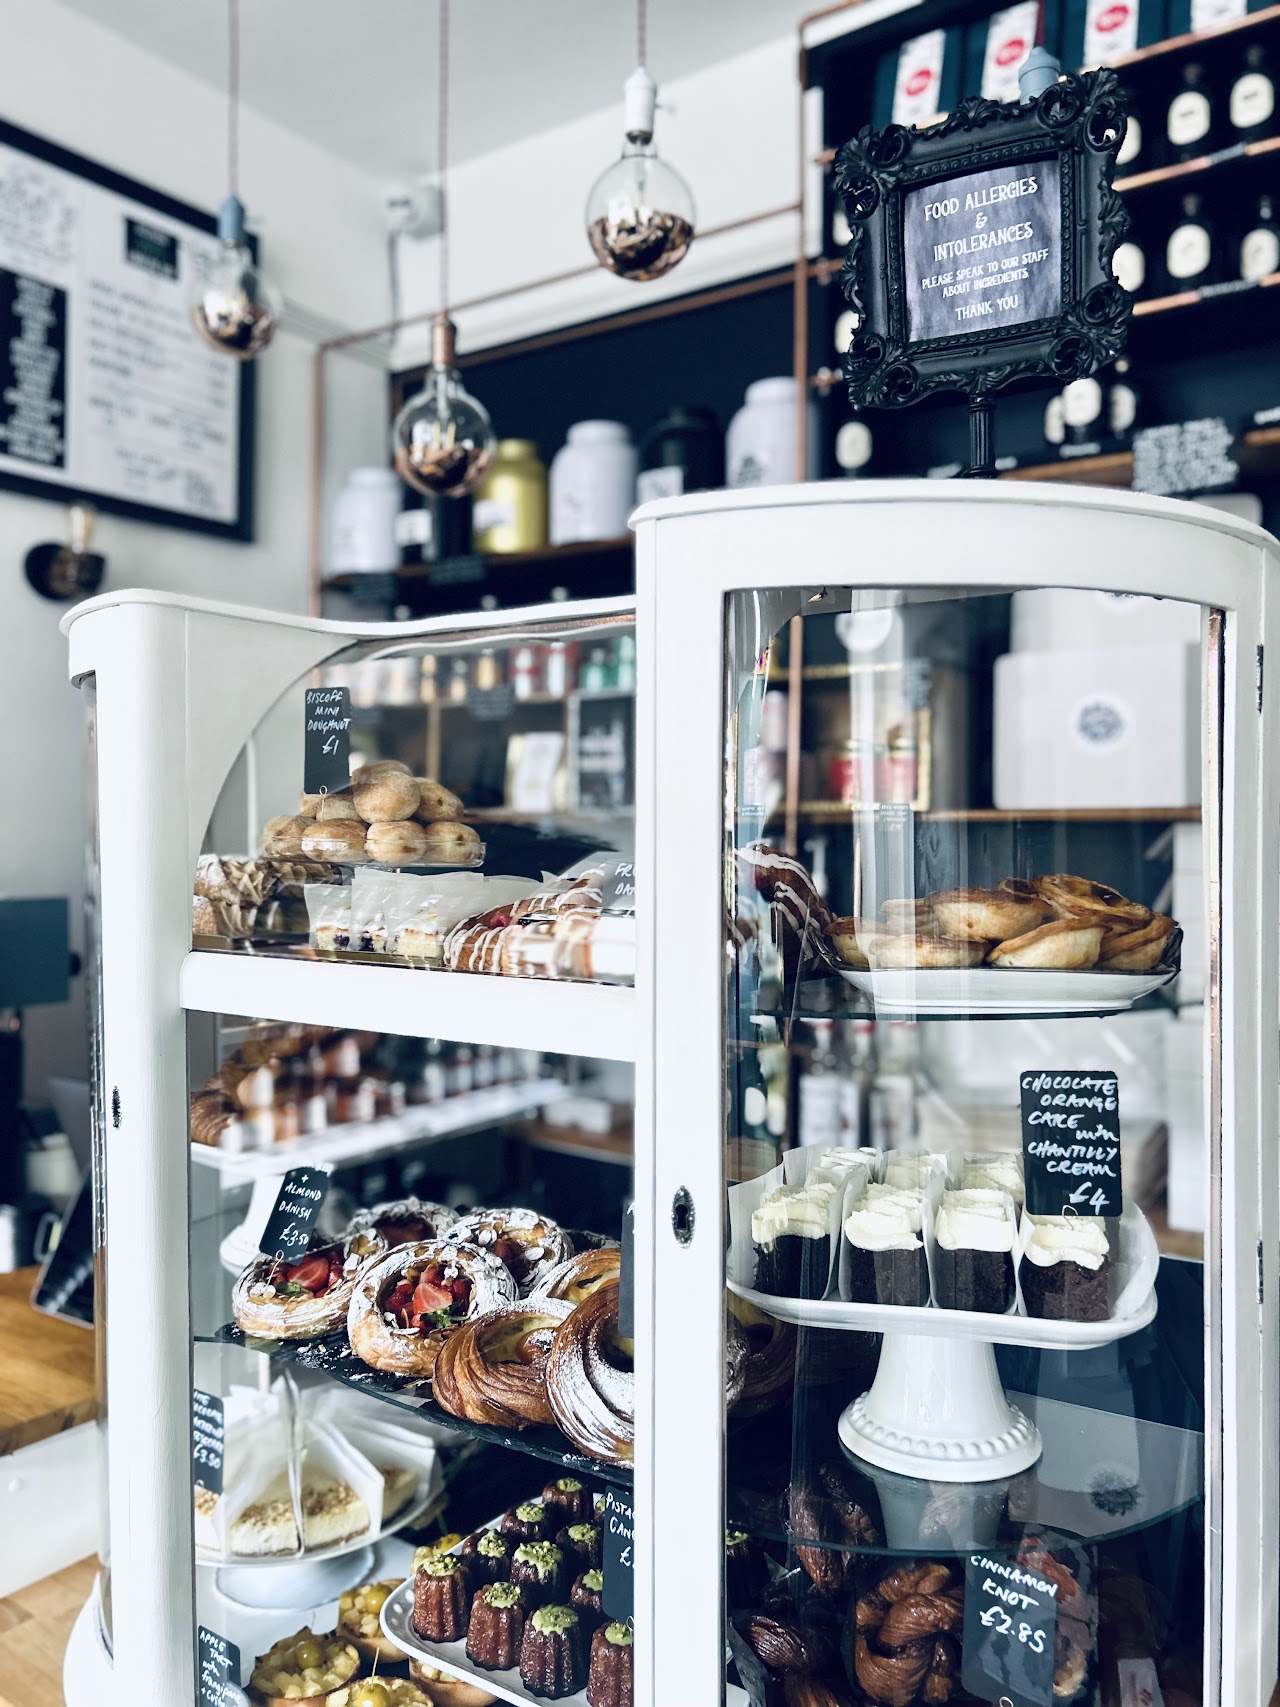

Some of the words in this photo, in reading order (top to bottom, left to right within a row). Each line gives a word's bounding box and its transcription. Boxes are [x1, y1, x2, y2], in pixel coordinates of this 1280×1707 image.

[924, 198, 960, 221] FOOD
[964, 176, 1038, 211] ALLERGIES
[975, 212, 988, 229] &
[933, 221, 1034, 262] INTOLERANCES
[921, 271, 954, 290] PLEASE
[955, 264, 984, 282] SPEAK
[986, 261, 999, 273] TO
[1001, 256, 1019, 269] OUR
[1021, 248, 1049, 265] STAFF
[942, 281, 971, 299] ABOUT
[954, 301, 994, 321] THANK
[996, 294, 1020, 311] YOU
[306, 689, 344, 705] BISCOFF
[314, 706, 340, 716] MINI
[307, 718, 352, 735] DOUGHNUT
[321, 734, 340, 756] £1
[614, 862, 635, 878] FR
[1021, 1072, 1118, 1096] CHOCOLATE
[1040, 1093, 1117, 1113] ORANGE
[1027, 1110, 1085, 1129] CAKE
[1027, 1140, 1118, 1162] CHANTILLY
[1046, 1159, 1118, 1178] CREAM
[284, 1181, 322, 1201] ALMOND
[1068, 1180, 1110, 1216] £4
[278, 1200, 313, 1221] DANISH
[278, 1221, 310, 1247] £3.50
[970, 1554, 1059, 1598] CINNAMON
[981, 1577, 1040, 1610] KNOT
[979, 1605, 1047, 1654] £2.85
[199, 1630, 226, 1652] APPLE
[209, 1647, 233, 1668] TART
